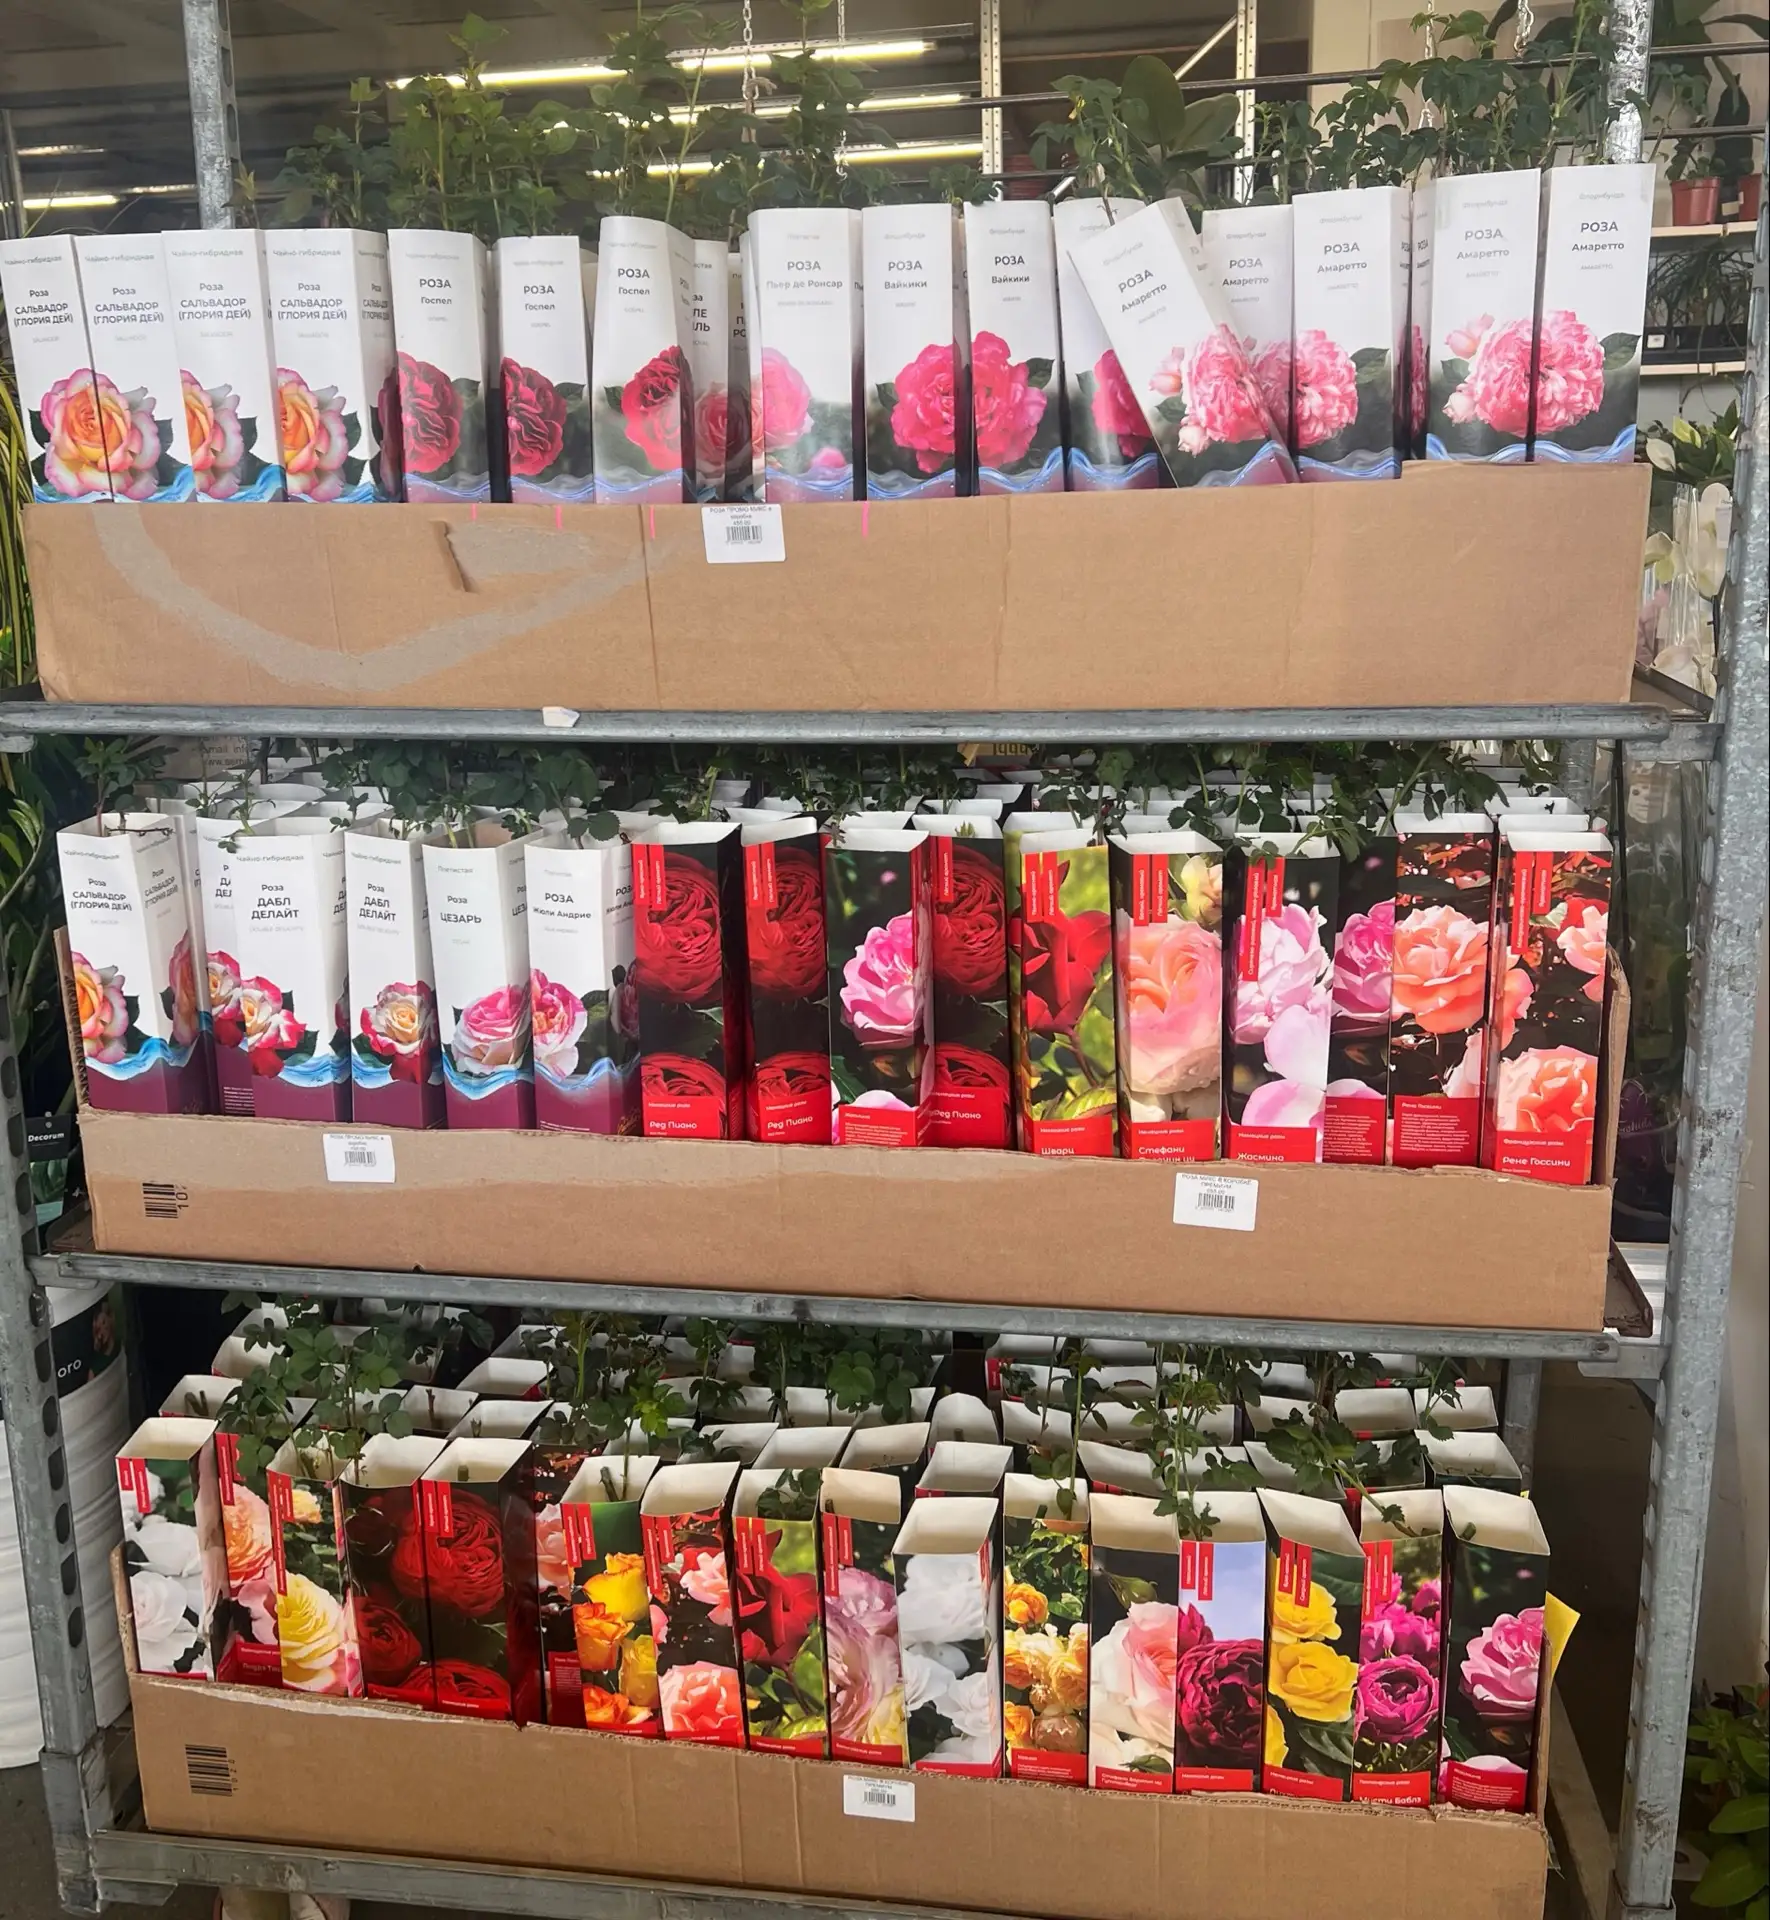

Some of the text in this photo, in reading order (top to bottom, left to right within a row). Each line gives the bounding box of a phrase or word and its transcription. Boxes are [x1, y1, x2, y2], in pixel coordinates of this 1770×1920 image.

[1580, 221, 1619, 233] РОЗА
[1464, 228, 1504, 241] РОЗА
[1323, 242, 1360, 255] РОЗА
[1572, 241, 1624, 252] Амаретто
[1456, 249, 1510, 260] Амаретто
[787, 261, 821, 271] РОЗА
[888, 261, 922, 271] РОЗА
[994, 256, 1025, 266] РОЗА
[1229, 258, 1263, 269] РОЗА
[1317, 261, 1367, 273] Амаретто
[617, 268, 650, 279] РОЗА
[419, 278, 452, 289] РОЗА
[766, 280, 843, 289] Пьер де Ронсар
[884, 280, 927, 289] Вайкики
[991, 275, 1030, 284] Вайкики
[1118, 269, 1154, 293] РОЗА
[1222, 276, 1269, 287] Амаретто
[199, 283, 224, 291] Роза
[298, 283, 321, 291] Роза
[523, 285, 555, 295] РОЗА
[618, 287, 650, 296] Госпел
[180, 299, 247, 308] САЛЬВАДОР
[280, 299, 343, 308] САЛЬВАДОР
[420, 296, 452, 305] Госпел
[1121, 284, 1168, 313] Амаретто
[15, 303, 68, 314] САЛЬВАДОР
[95, 302, 159, 312] САЛЬВАДОР
[525, 303, 555, 312] Госпел
[93, 313, 164, 325] (ГЛОРИЯ ДЕЙ)
[178, 308, 251, 321] (ГЛОРИЯ ДЕЙ)
[278, 309, 347, 321] (ГЛОРИЯ ДЕЙ)
[14, 313, 74, 328] (ГЛОРИЯ ДЕЙ)
[88, 878, 107, 887] Роза
[261, 884, 284, 892] Роза
[367, 883, 385, 893] Роза
[72, 891, 127, 901] САЛЬВАДОР
[447, 896, 468, 904] Роза
[545, 893, 574, 903] РОЗА
[70, 902, 132, 912] (ГЛОРИЯ ДЕЙ)
[257, 897, 291, 907] ДАБЛ
[363, 896, 390, 908] ДАБЛ
[251, 908, 299, 920] ДЕЛАЙТ
[359, 908, 396, 921] ДЕЛАЙТ
[440, 912, 482, 924] ЦЕЗАРЬ
[533, 907, 592, 920] Жюли Андрие
[952, 1111, 981, 1119] Пиано
[650, 1121, 697, 1130] Ред Пиано
[767, 1115, 813, 1131] Ред Пиано
[28, 1132, 65, 1142] Decorum
[1138, 1146, 1184, 1155] Стефани
[1238, 1152, 1284, 1161] Жасмина
[1502, 1156, 1571, 1167] Рене Госсини
